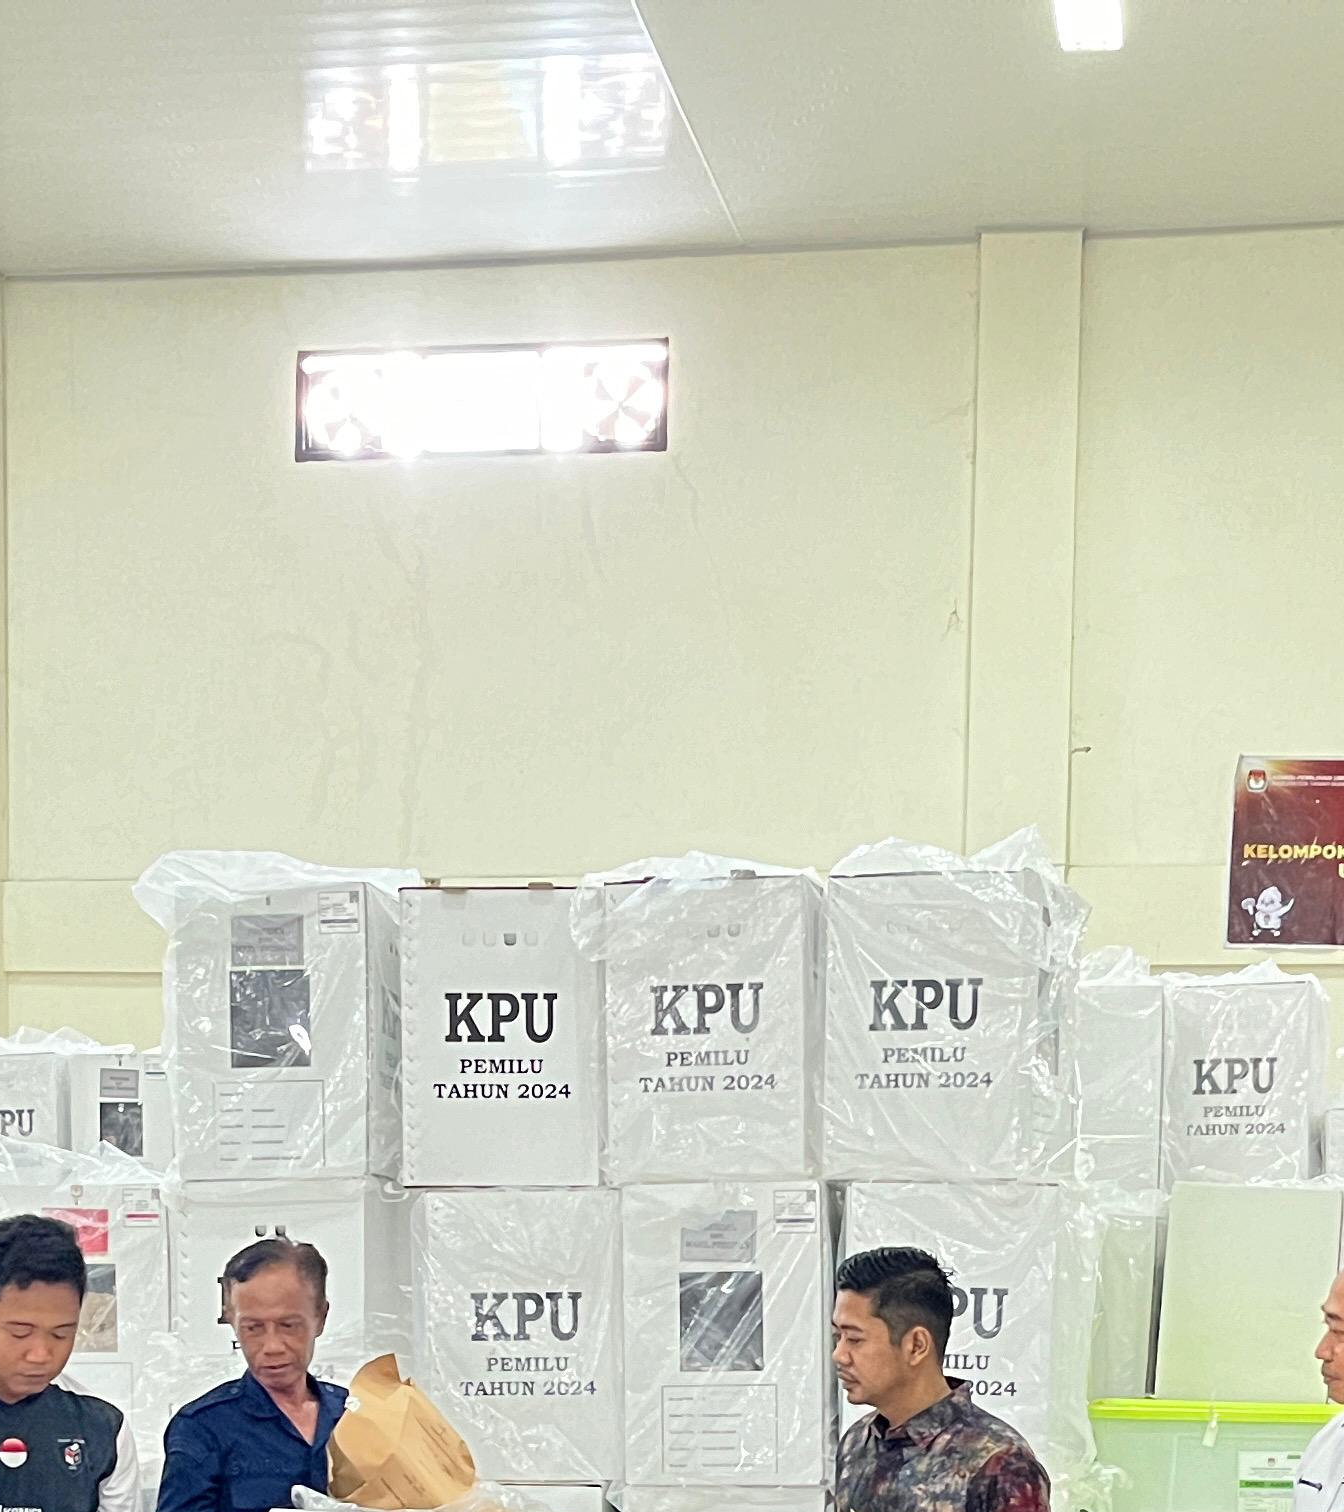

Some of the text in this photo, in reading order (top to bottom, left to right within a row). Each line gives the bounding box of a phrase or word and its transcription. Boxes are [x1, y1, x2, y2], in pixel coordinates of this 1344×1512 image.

[650, 982, 763, 1035] KPU
[869, 978, 983, 1031] KPU
[445, 993, 558, 1043] KPU
[666, 1049, 749, 1067] PEMILU
[882, 1046, 966, 1063] PEMILU
[460, 1059, 543, 1075] PEMILU
[1192, 1057, 1278, 1095] KPU
[640, 1073, 776, 1093] TAHUN 2024
[855, 1072, 993, 1090] TAHUN 2024
[434, 1083, 571, 1100] TAHUN 2024
[1204, 1105, 1266, 1118] PEMILU
[1186, 1123, 1286, 1136] TAHUN 2024
[470, 1291, 582, 1341] KPU
[487, 1356, 570, 1372] PEMILU
[459, 1380, 597, 1396] TAHUN 2024
